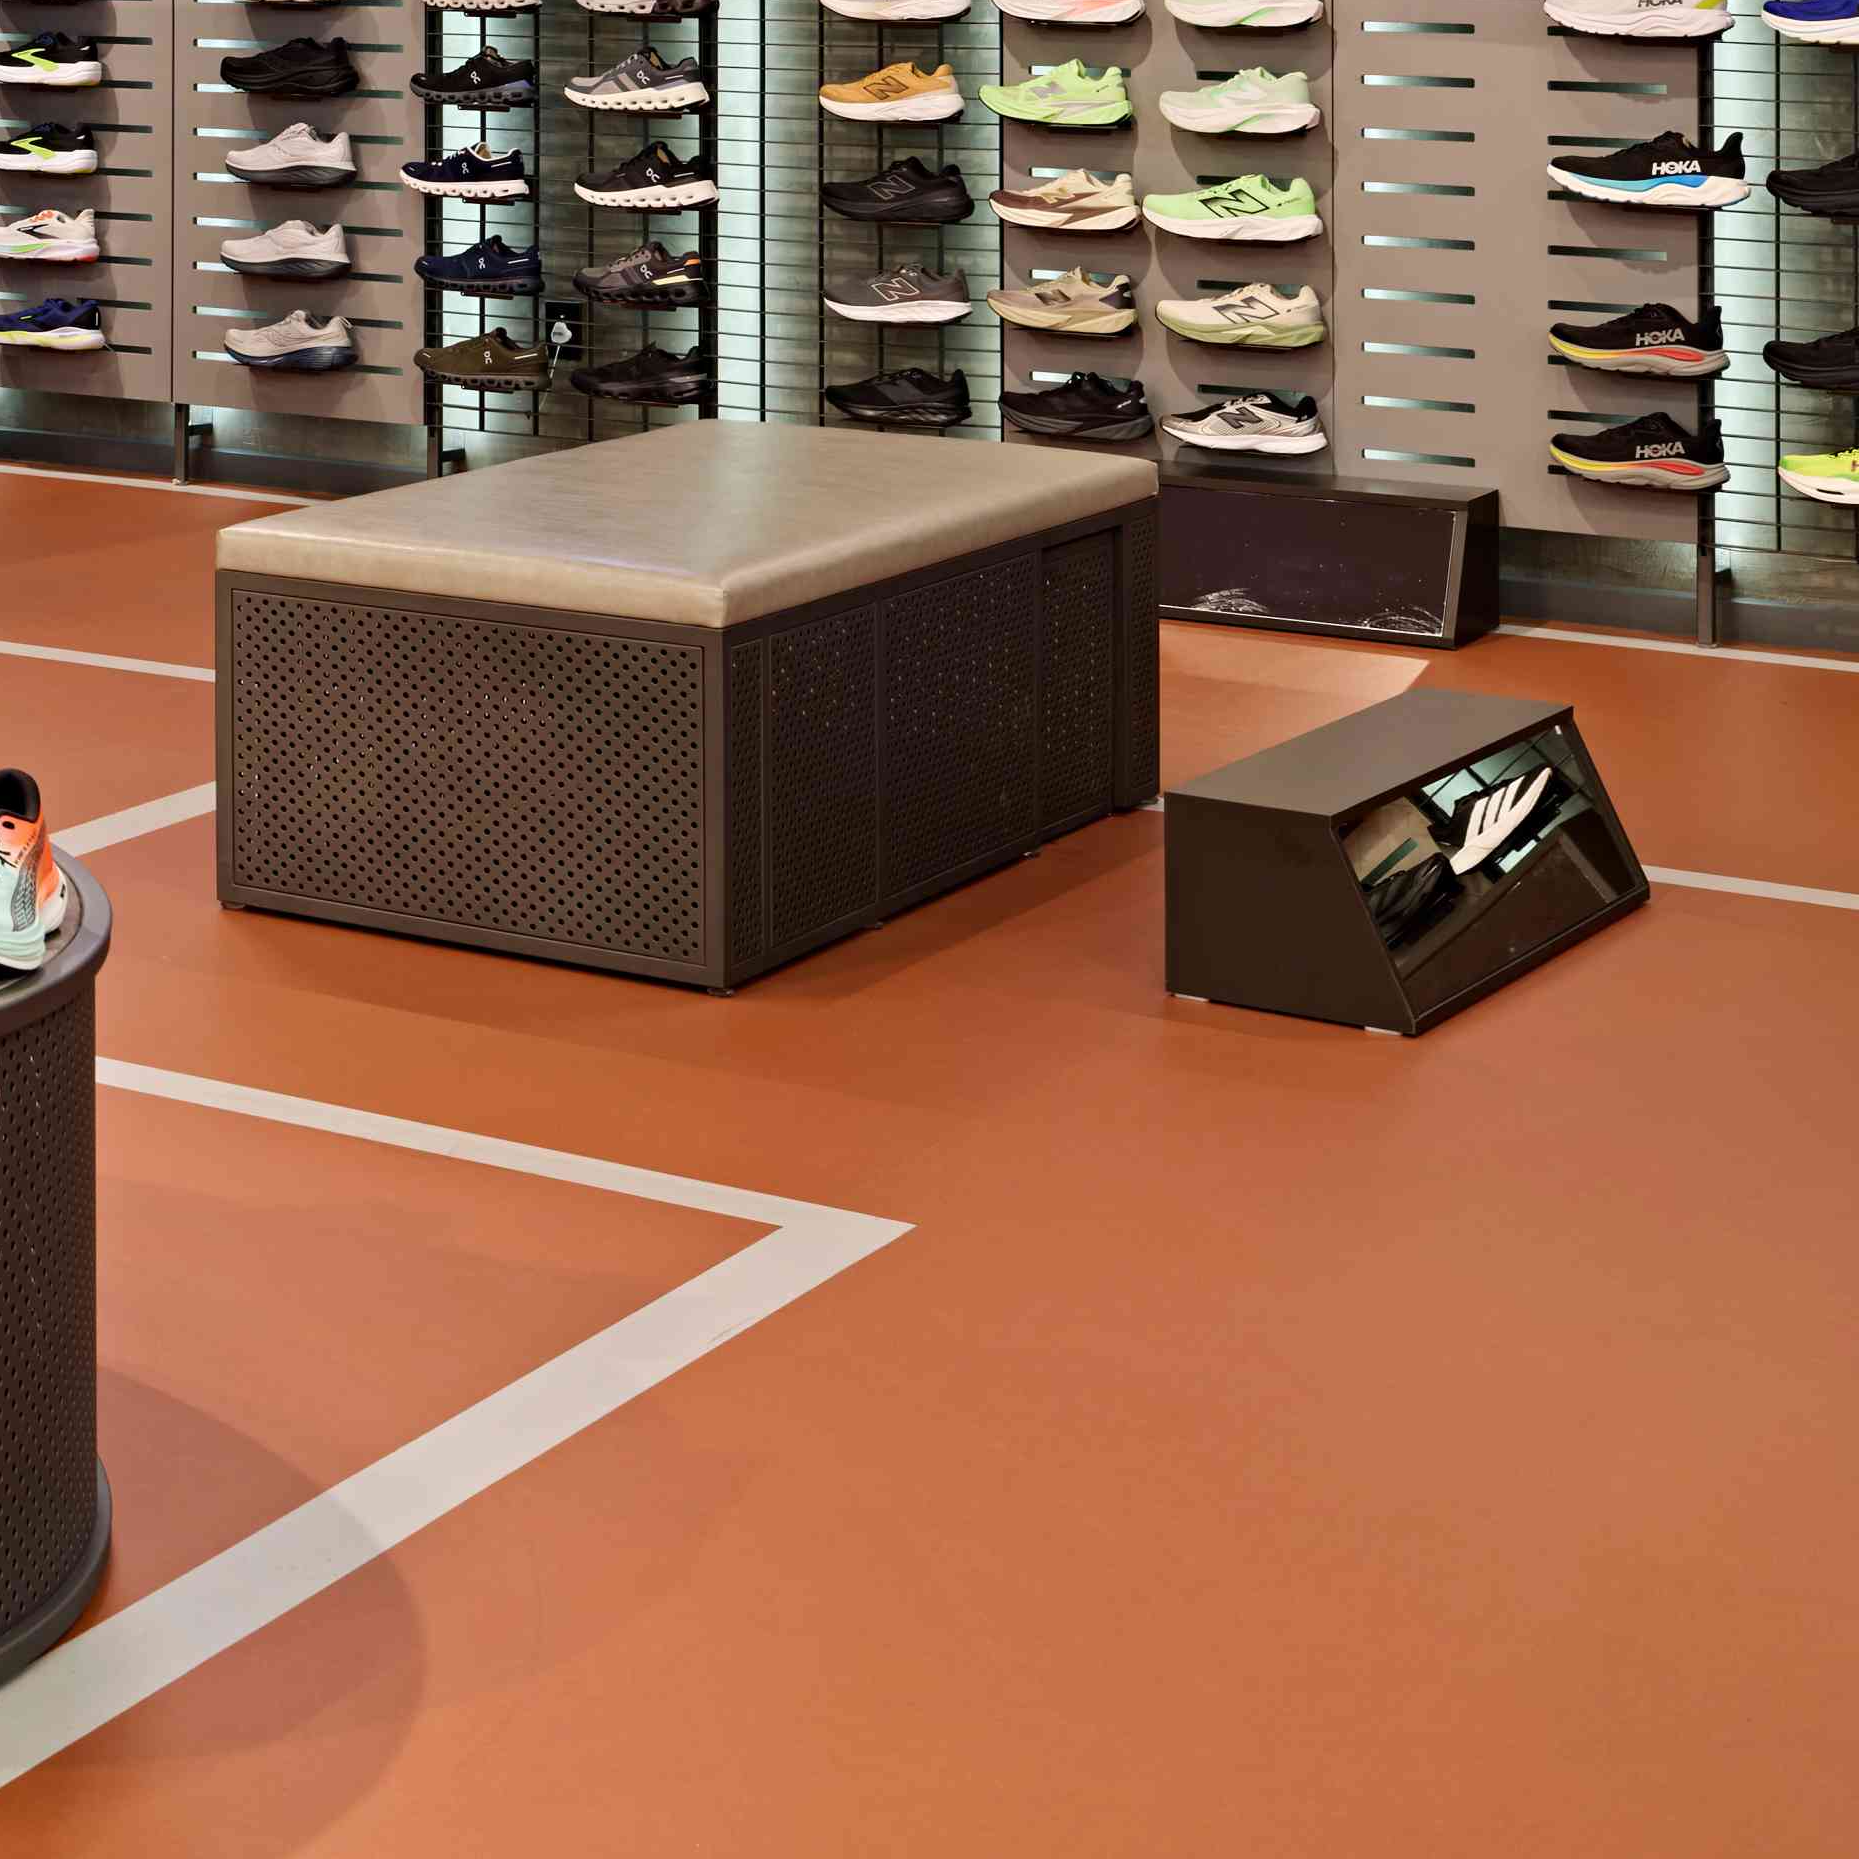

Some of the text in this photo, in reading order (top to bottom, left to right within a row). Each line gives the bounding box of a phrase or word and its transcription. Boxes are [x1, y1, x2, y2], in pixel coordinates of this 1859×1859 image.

[1651, 159, 1702, 176] HOKA
[1635, 328, 1685, 346] HOKA
[1635, 441, 1686, 459] HOKA
